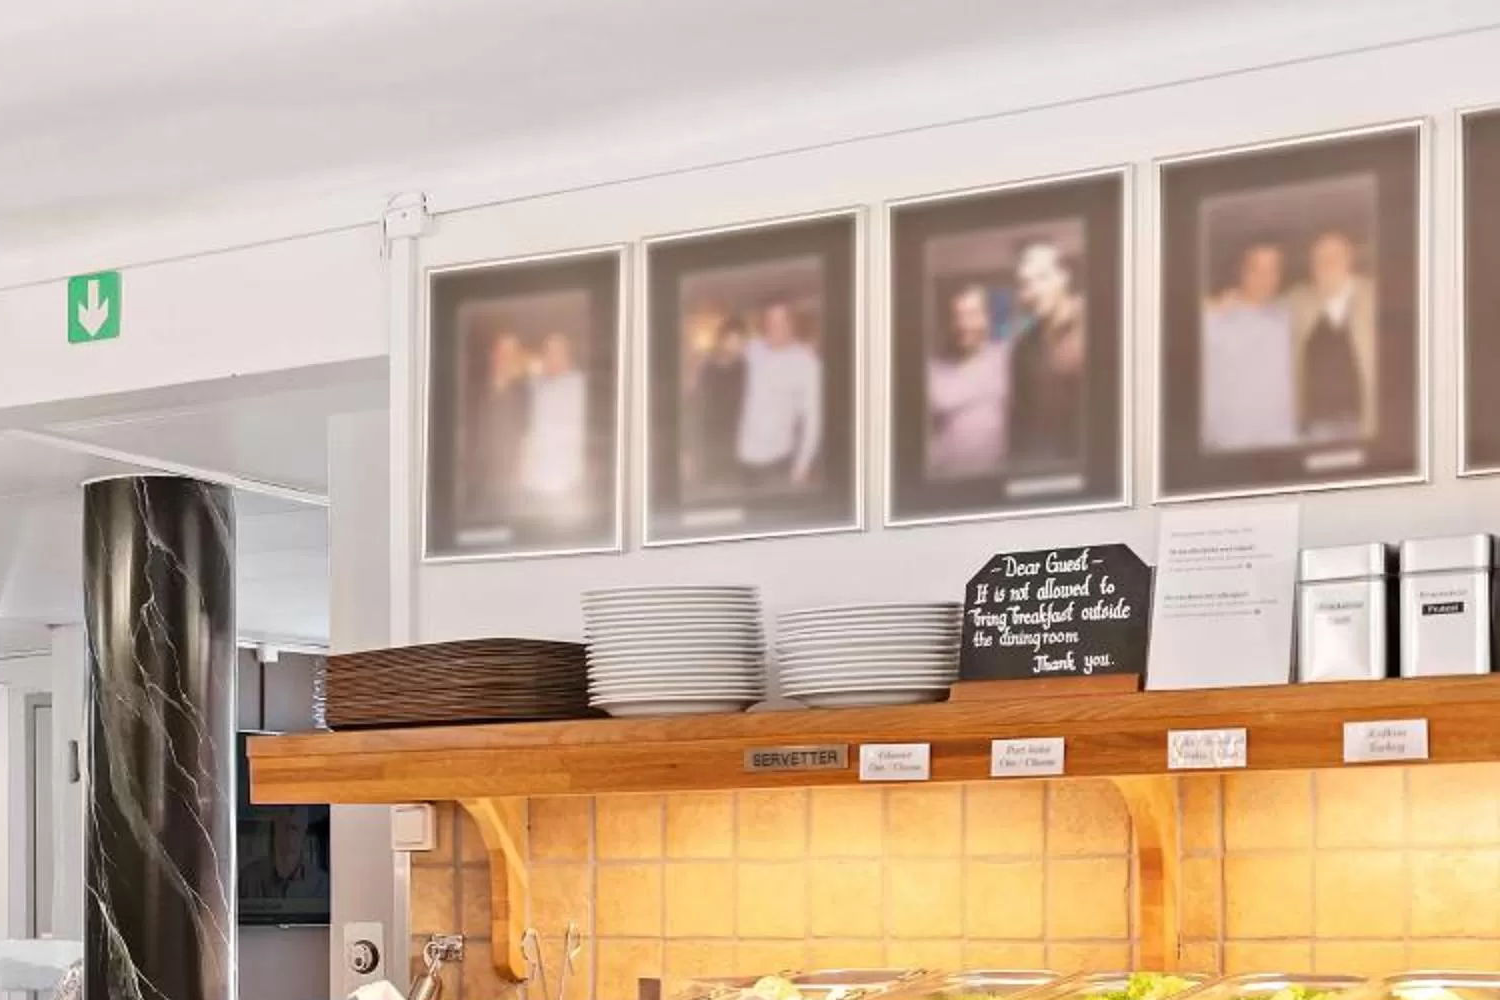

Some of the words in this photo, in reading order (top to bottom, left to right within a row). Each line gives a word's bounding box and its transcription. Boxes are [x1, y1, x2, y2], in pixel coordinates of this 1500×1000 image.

[1001, 556, 1040, 577] Dear
[1045, 549, 1090, 574] Guest
[994, 586, 1005, 603] is
[1009, 582, 1030, 601] not
[1037, 575, 1092, 600] allowed
[1099, 575, 1115, 595] to
[968, 605, 1007, 632] bring
[1006, 601, 1075, 630] breakfast
[1081, 597, 1131, 621] outside
[973, 630, 993, 648] the
[1033, 651, 1077, 674] Thank
[753, 750, 837, 767] SERVETTER
